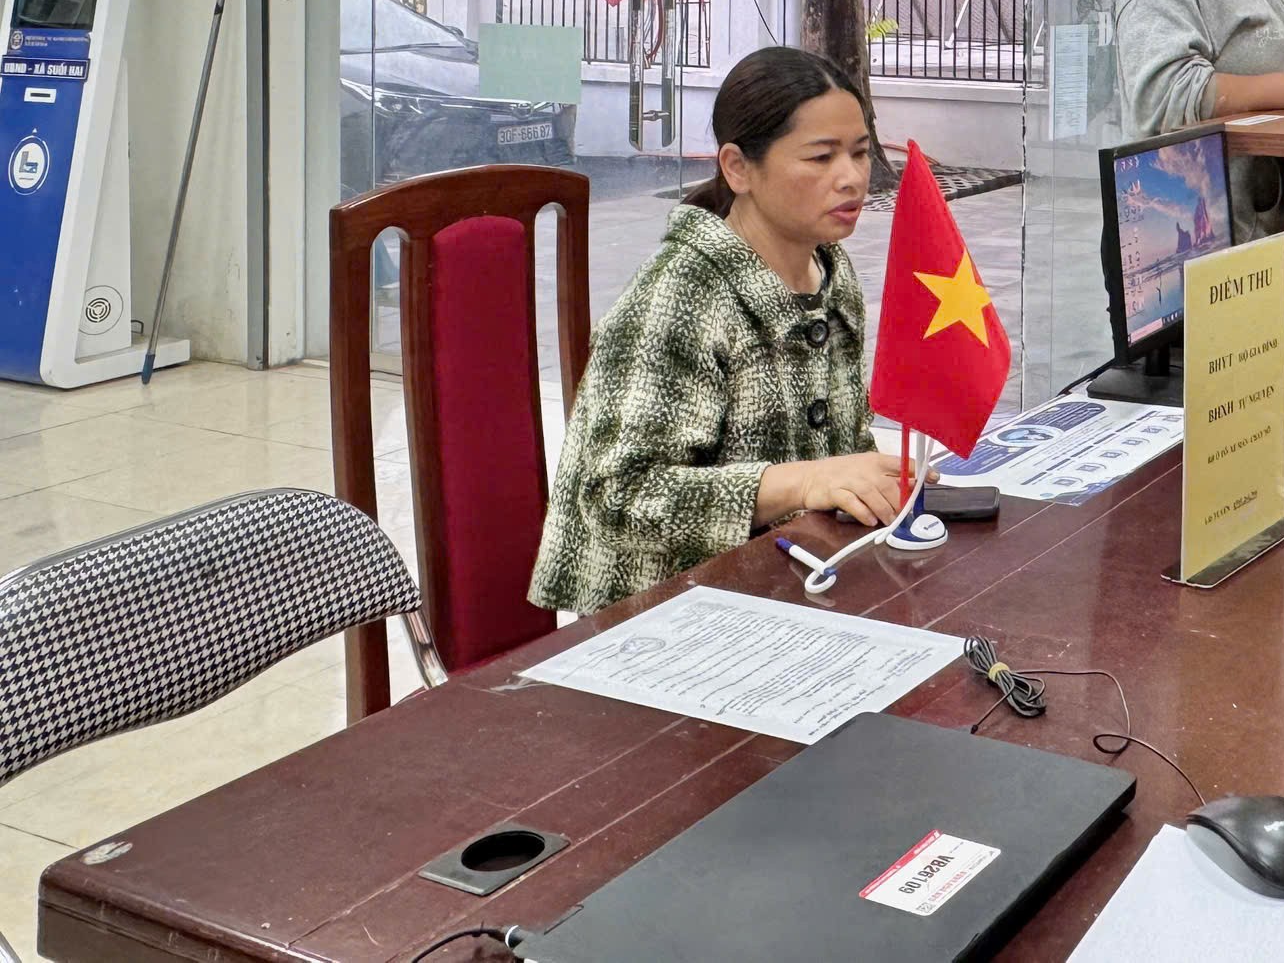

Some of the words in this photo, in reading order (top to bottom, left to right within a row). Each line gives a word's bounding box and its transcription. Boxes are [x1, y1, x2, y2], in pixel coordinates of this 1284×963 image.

[1247, 266, 1273, 292] THU
[1208, 353, 1233, 375] BHYT
[1208, 400, 1234, 424] BHXH
